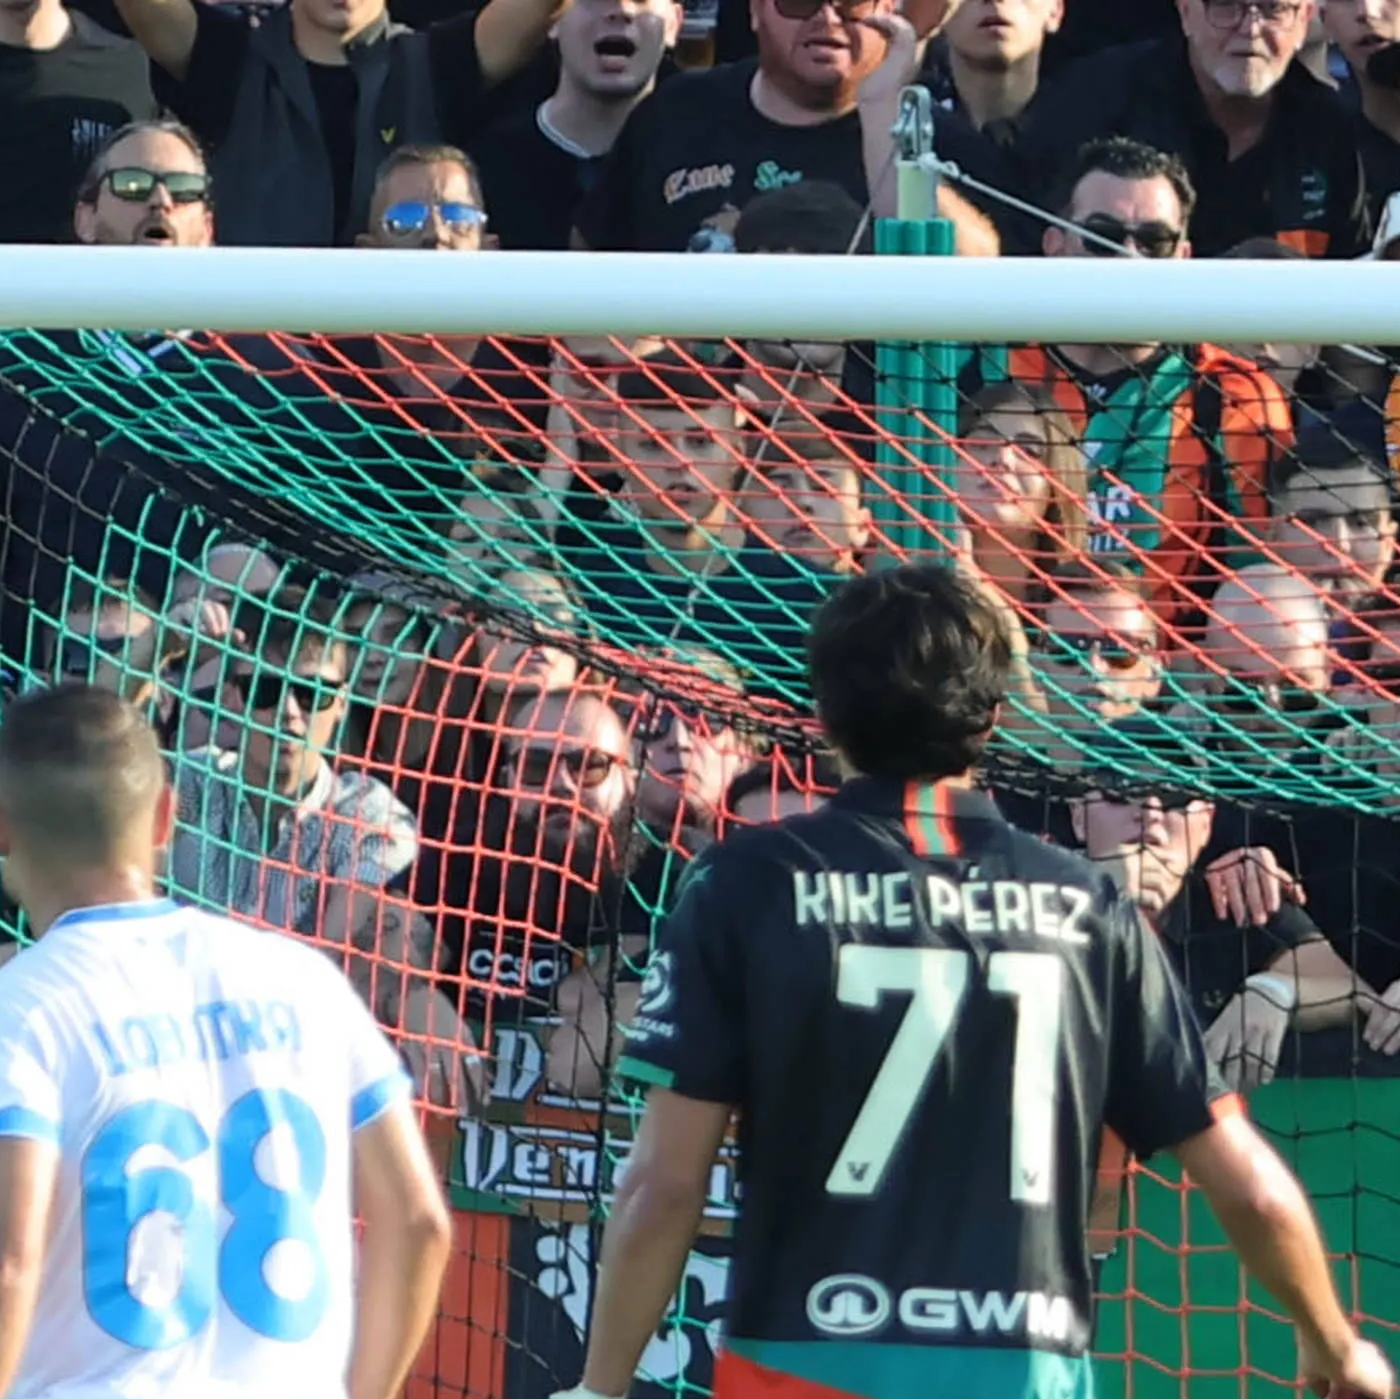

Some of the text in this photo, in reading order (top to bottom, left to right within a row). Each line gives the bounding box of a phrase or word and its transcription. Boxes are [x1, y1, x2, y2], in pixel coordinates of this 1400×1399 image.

[795, 866, 1097, 943] KIKE PÉREZ
[825, 944, 1062, 1201] 71
[82, 1087, 332, 1351] 68
[898, 1287, 1070, 1340] GWM
